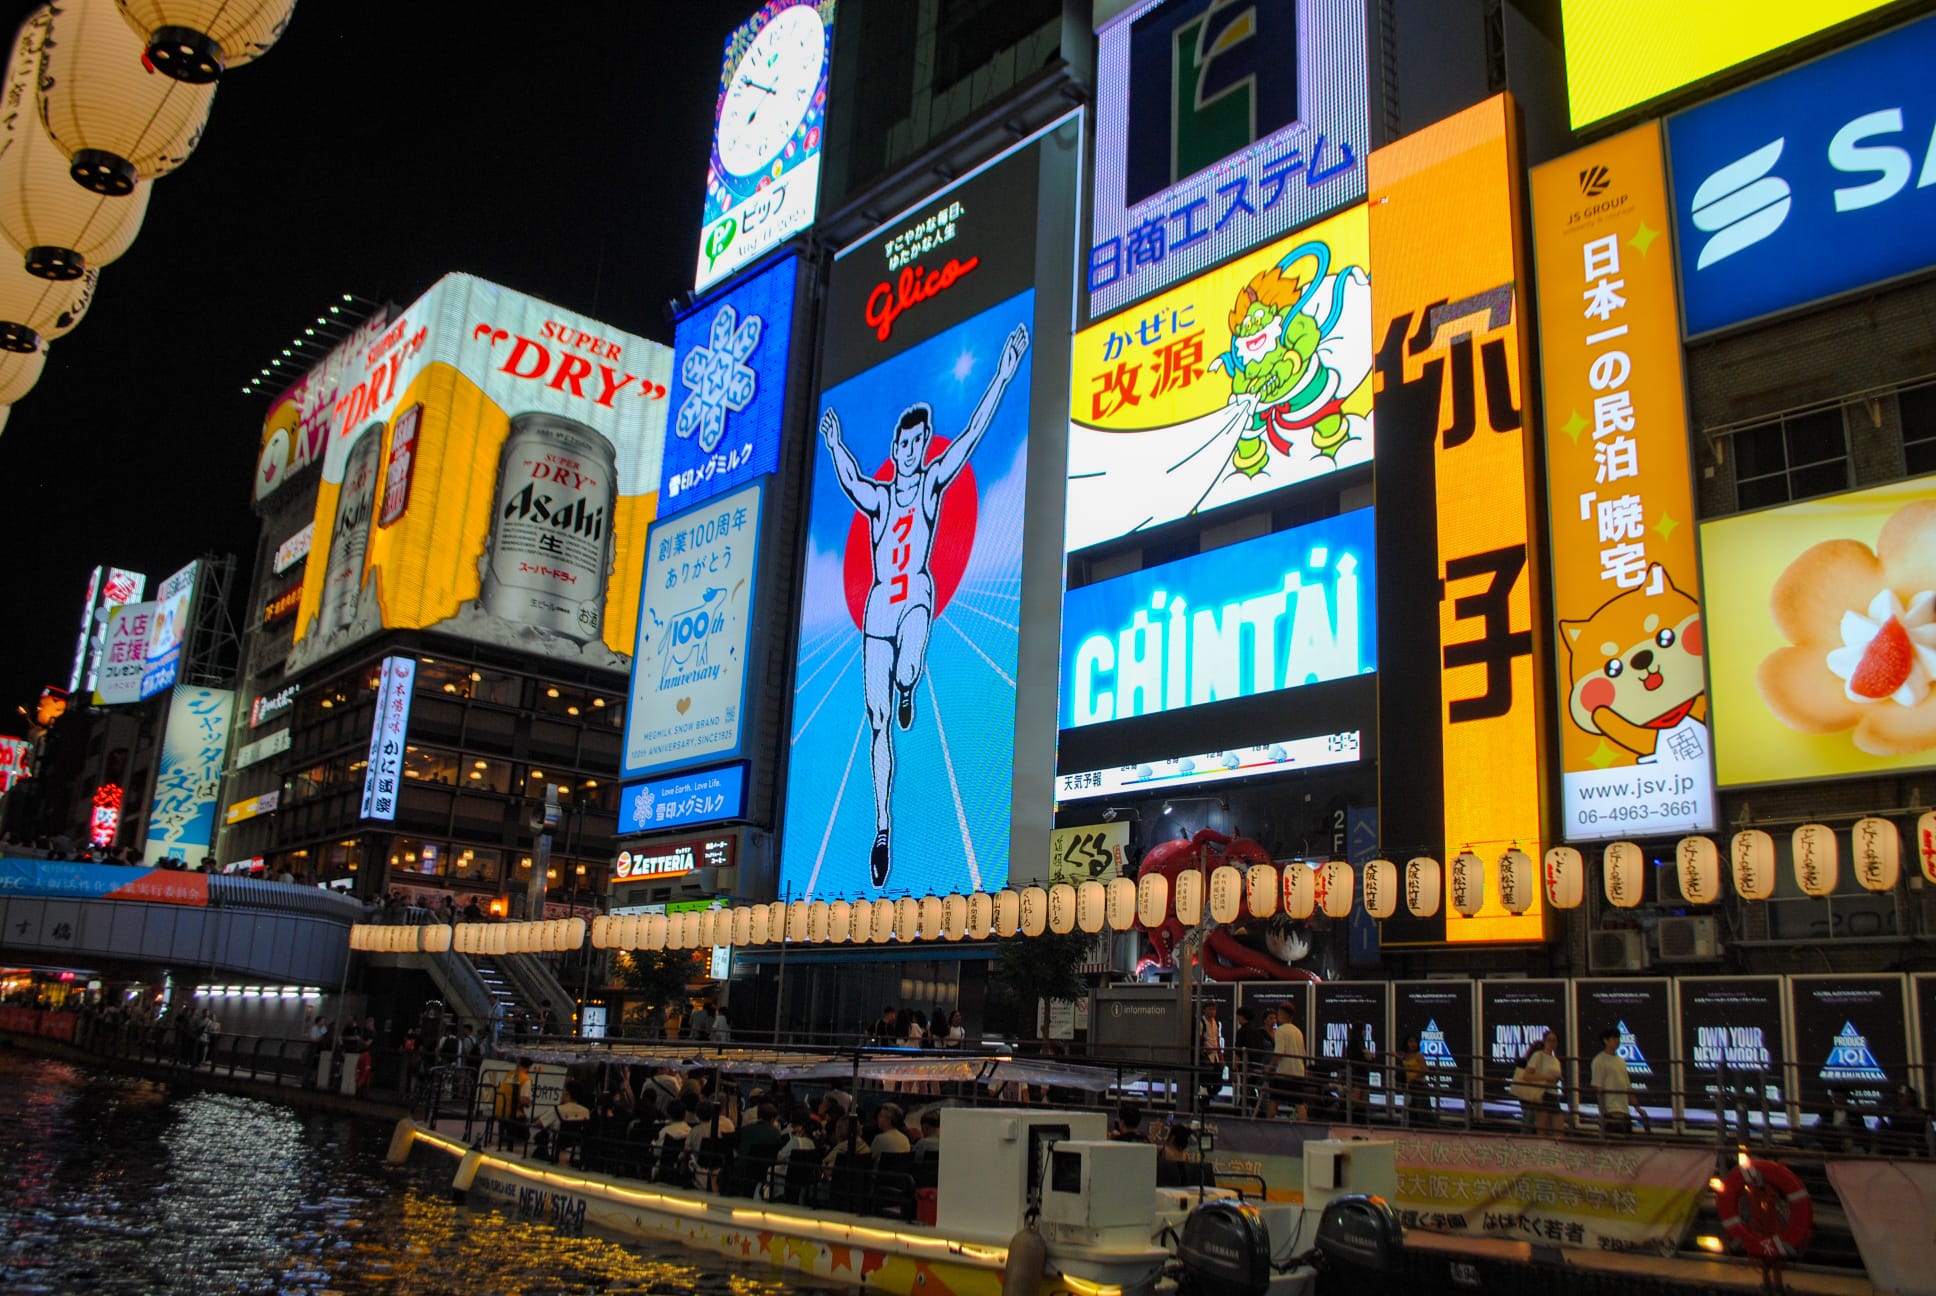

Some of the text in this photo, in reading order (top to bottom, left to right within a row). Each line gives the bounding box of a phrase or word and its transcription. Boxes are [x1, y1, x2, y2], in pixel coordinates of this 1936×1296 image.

[1828, 107, 1936, 213] S
[1087, 132, 1356, 293] 日商エステム
[1583, 194, 1629, 217] GROUP
[888, 222, 957, 272] ゆたかな人生
[540, 319, 623, 362] SUPER
[1102, 304, 1196, 362] かぜに
[1091, 328, 1205, 421] 改源
[545, 453, 580, 470] SUPER
[669, 443, 754, 497] 雪印メグミルク
[503, 481, 604, 541] Asahi
[539, 534, 564, 554] 生
[657, 507, 748, 562] 創業100周年
[665, 546, 732, 590] ありがとう
[889, 507, 916, 605] グリコ
[518, 561, 578, 585] スーパードライ
[113, 614, 149, 638] 入店
[672, 611, 725, 648] 100th
[643, 716, 720, 742] MEGMILK SNOW BRAND
[187, 690, 226, 799] シャッターは
[661, 785, 675, 797] Love
[694, 781, 708, 793] Love
[1064, 771, 1102, 791] 天気予報
[1579, 774, 1694, 800] www.jsv.jp
[655, 794, 725, 823] 雪印メグミルク
[1578, 800, 1699, 825] 06-4963-3661
[631, 852, 695, 876] ZETTERIA
[1063, 832, 1113, 877] くくる
[1366, 863, 1379, 911] 大阪松竹座
[1408, 861, 1420, 910] 大阪松竹座
[1452, 857, 1467, 907] 大阪松竹座
[1500, 854, 1515, 905] 大阪松竹座
[1023, 890, 1033, 928] くれおーる
[1052, 887, 1062, 926] くれおーる
[1123, 1004, 1166, 1017] information
[1326, 1022, 1348, 1040] OWN
[1496, 1024, 1522, 1043] OWN
[1698, 1026, 1763, 1048] OWN YOUR
[1833, 1036, 1866, 1047] PRODUCE
[1323, 1039, 1344, 1057] NEW
[1423, 1041, 1444, 1055] 101
[1492, 1043, 1517, 1063] NEW
[1693, 1046, 1770, 1070] NEW WORLD
[1838, 1049, 1866, 1065] 101
[532, 1085, 560, 1102] ORTS
[519, 1187, 587, 1224] NEW STAR
